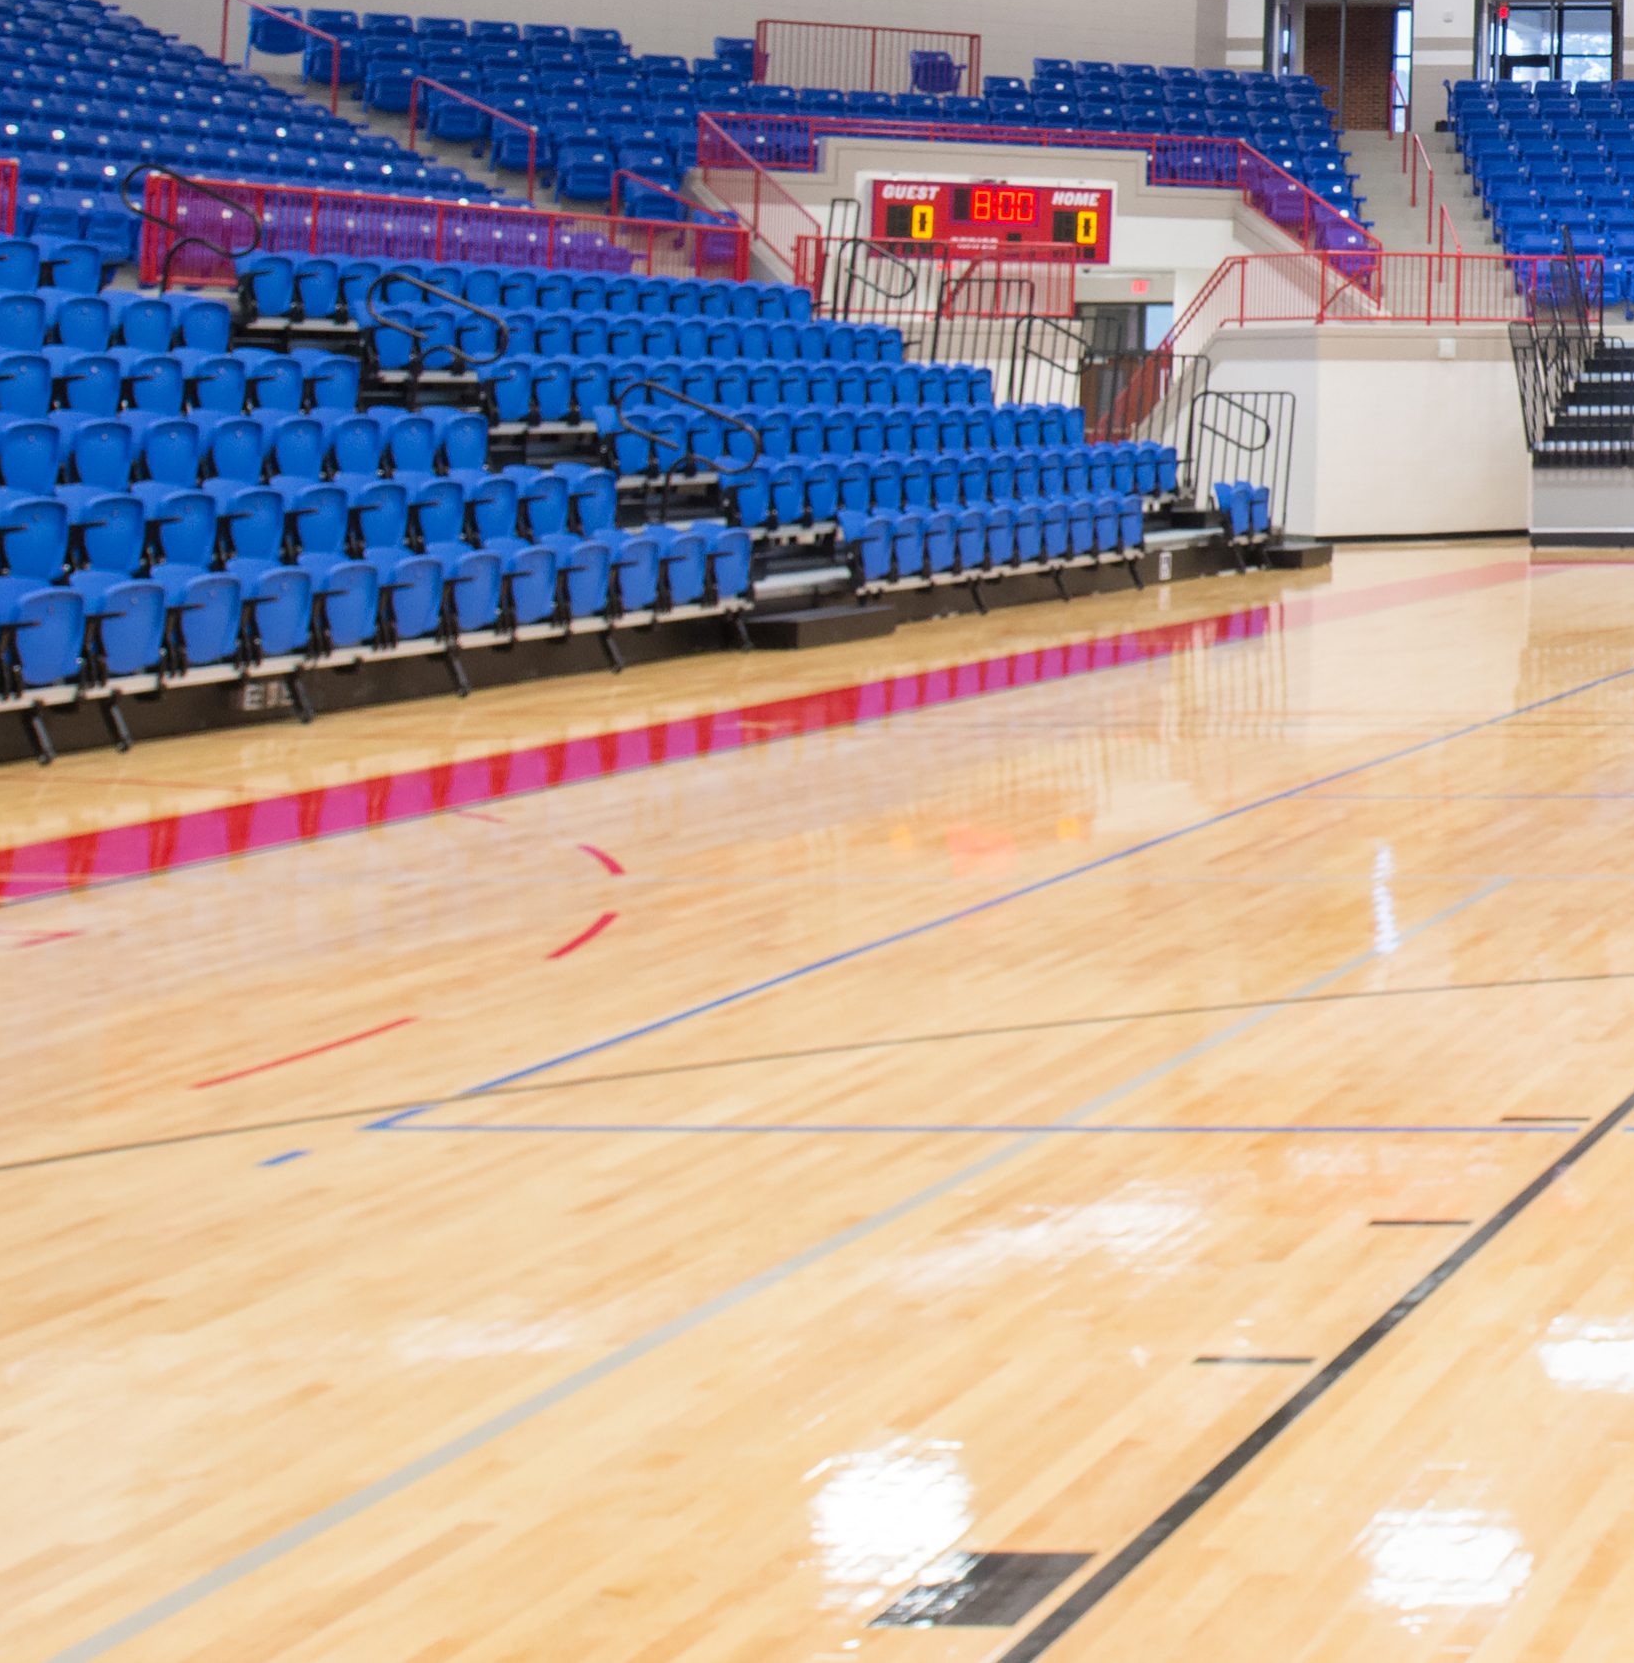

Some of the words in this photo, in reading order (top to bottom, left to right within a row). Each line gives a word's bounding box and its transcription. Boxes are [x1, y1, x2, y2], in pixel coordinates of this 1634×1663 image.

[881, 183, 940, 201] GUEST
[972, 188, 1036, 222] 8:00
[1051, 191, 1101, 207] HOME
[910, 204, 934, 240] 0
[1076, 210, 1098, 244] 0
